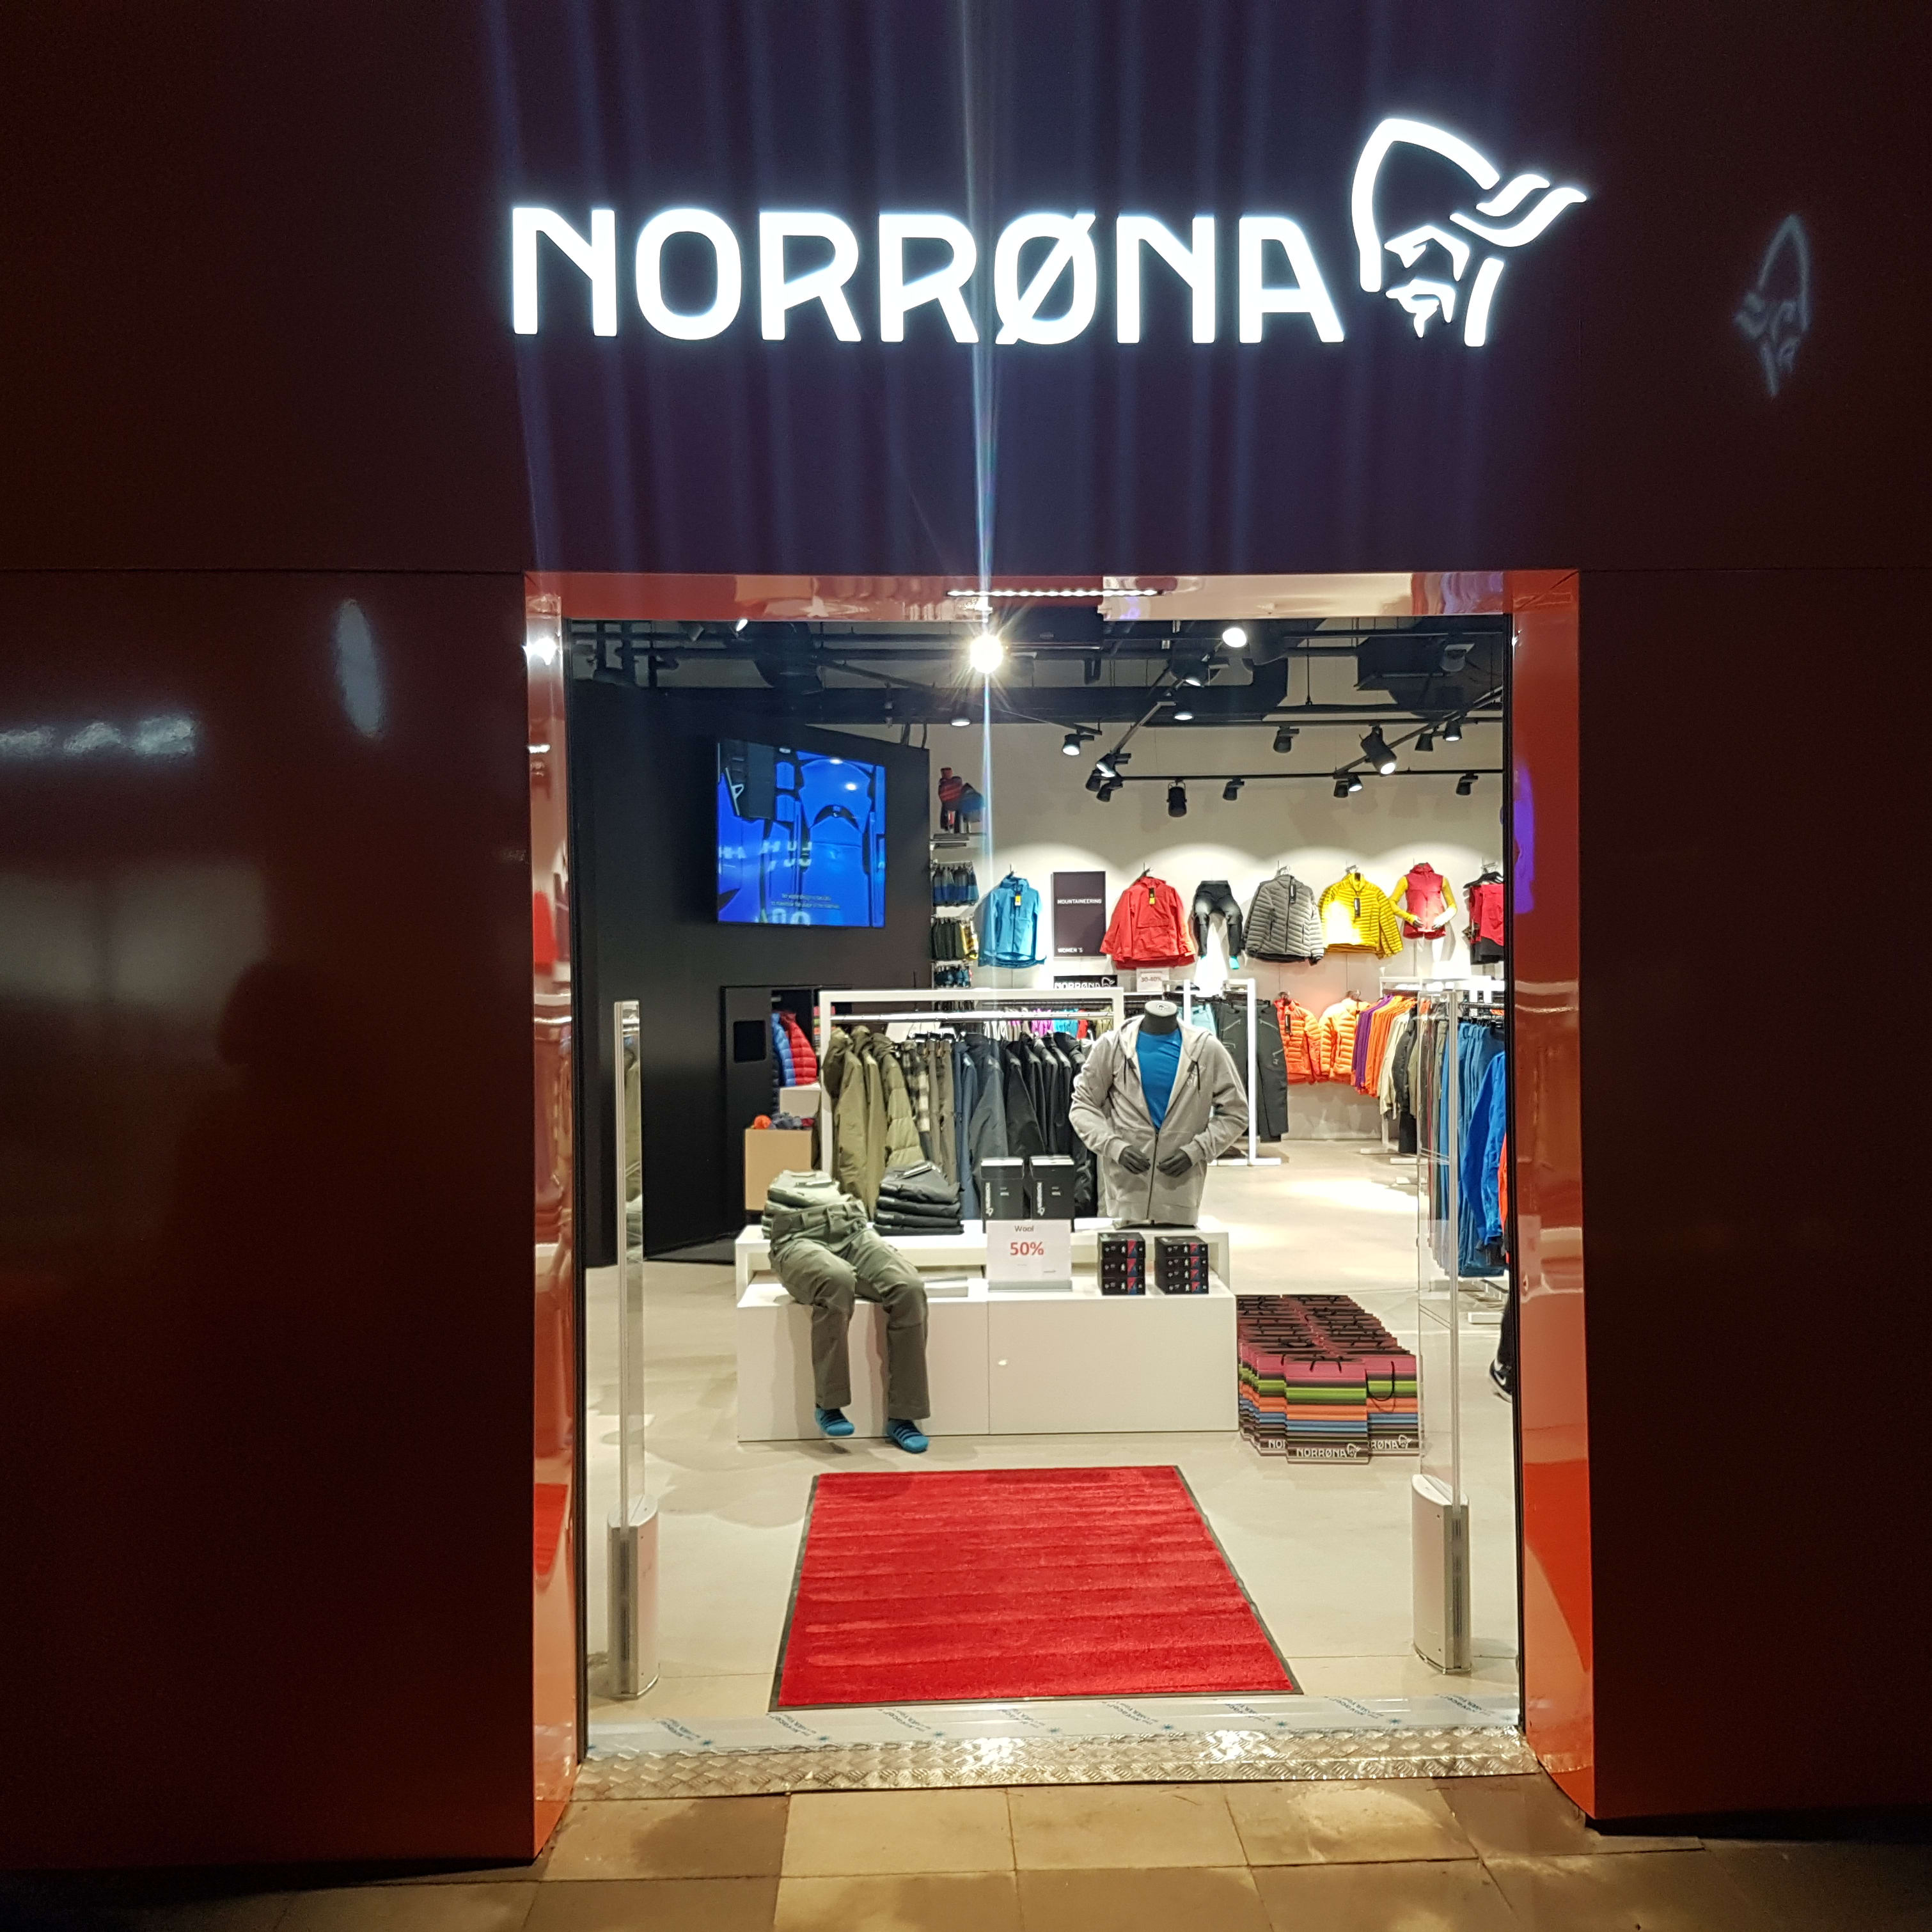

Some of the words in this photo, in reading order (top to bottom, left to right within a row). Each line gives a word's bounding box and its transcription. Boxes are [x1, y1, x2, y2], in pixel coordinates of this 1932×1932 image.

[512, 207, 1344, 345] NORRØNA
[1010, 1241, 1044, 1255] 50%
[1296, 1448, 1347, 1457] NORRØNA
